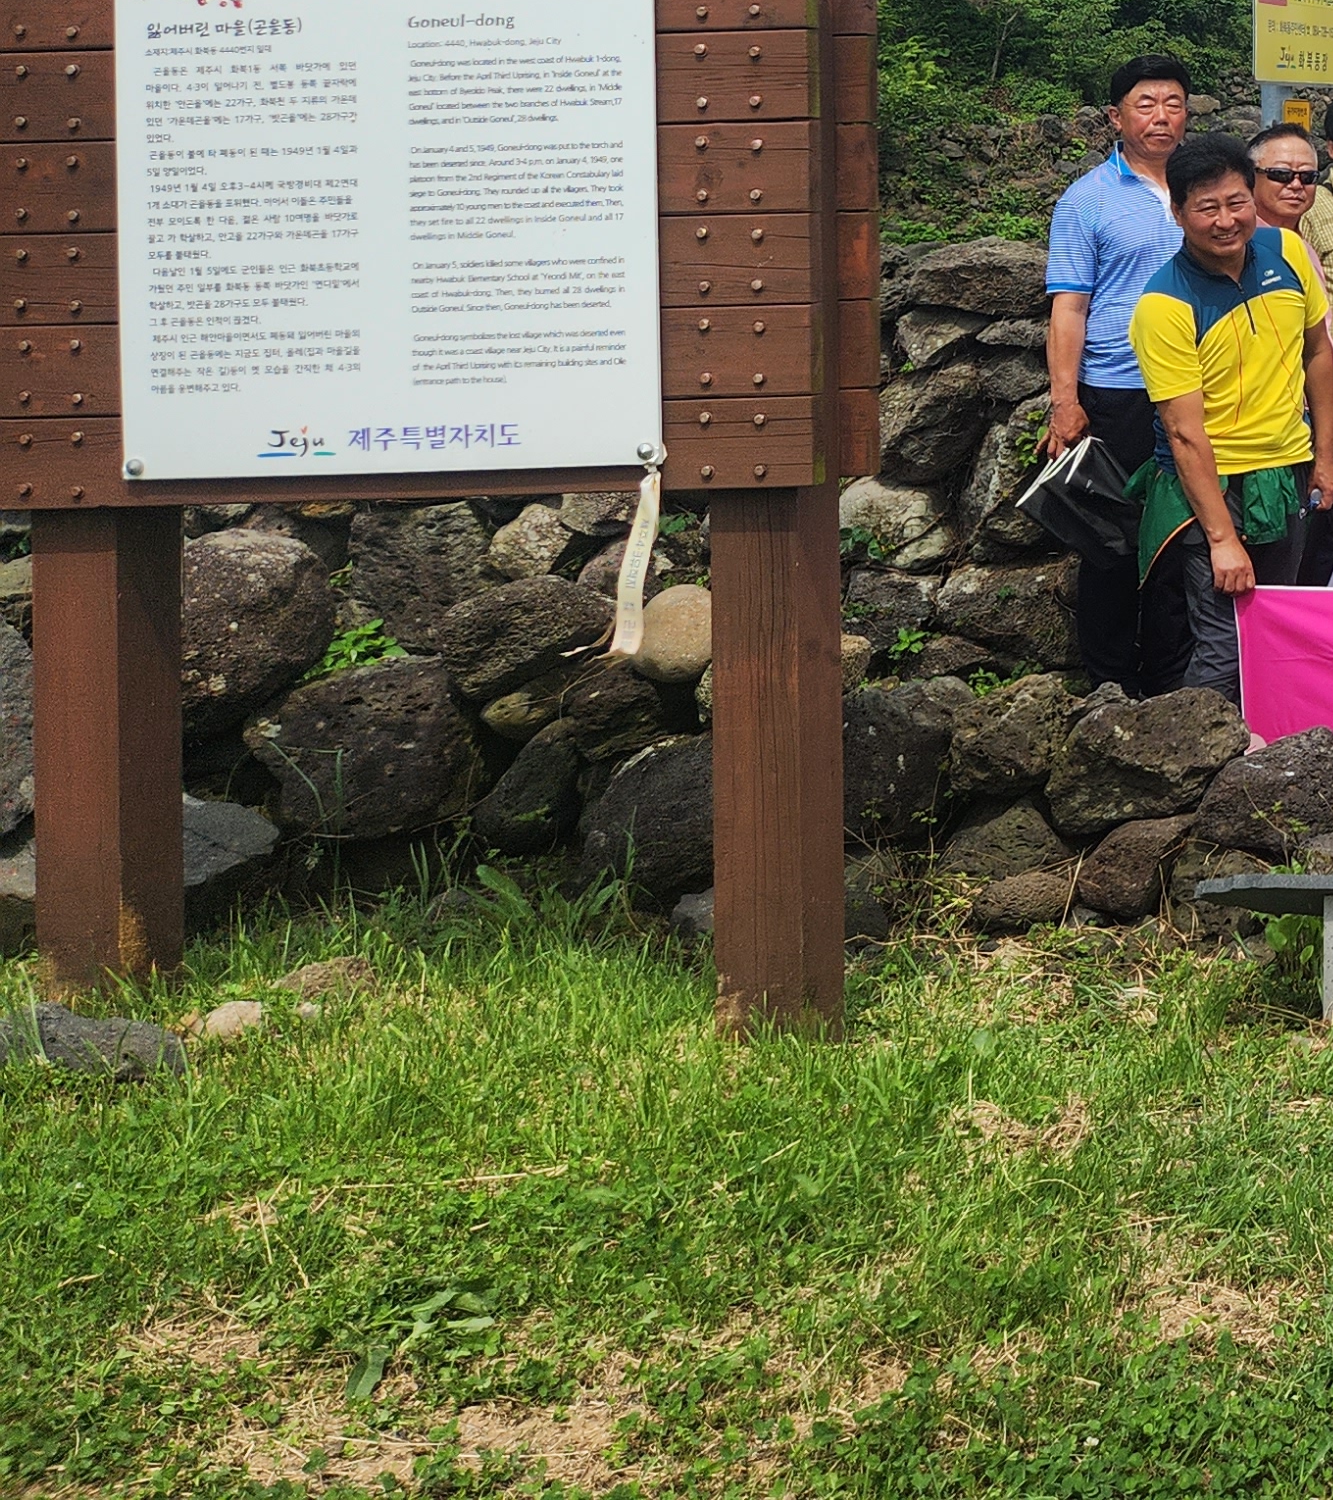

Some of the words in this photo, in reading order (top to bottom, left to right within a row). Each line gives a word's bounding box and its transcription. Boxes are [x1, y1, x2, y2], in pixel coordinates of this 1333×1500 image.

[146, 20, 210, 39] 잃어버린
[214, 16, 302, 37] 마을(곤을동)
[407, 12, 515, 32] Goneul-dong
[267, 426, 325, 457] Jeju
[347, 423, 522, 451] 제주특별자치도
